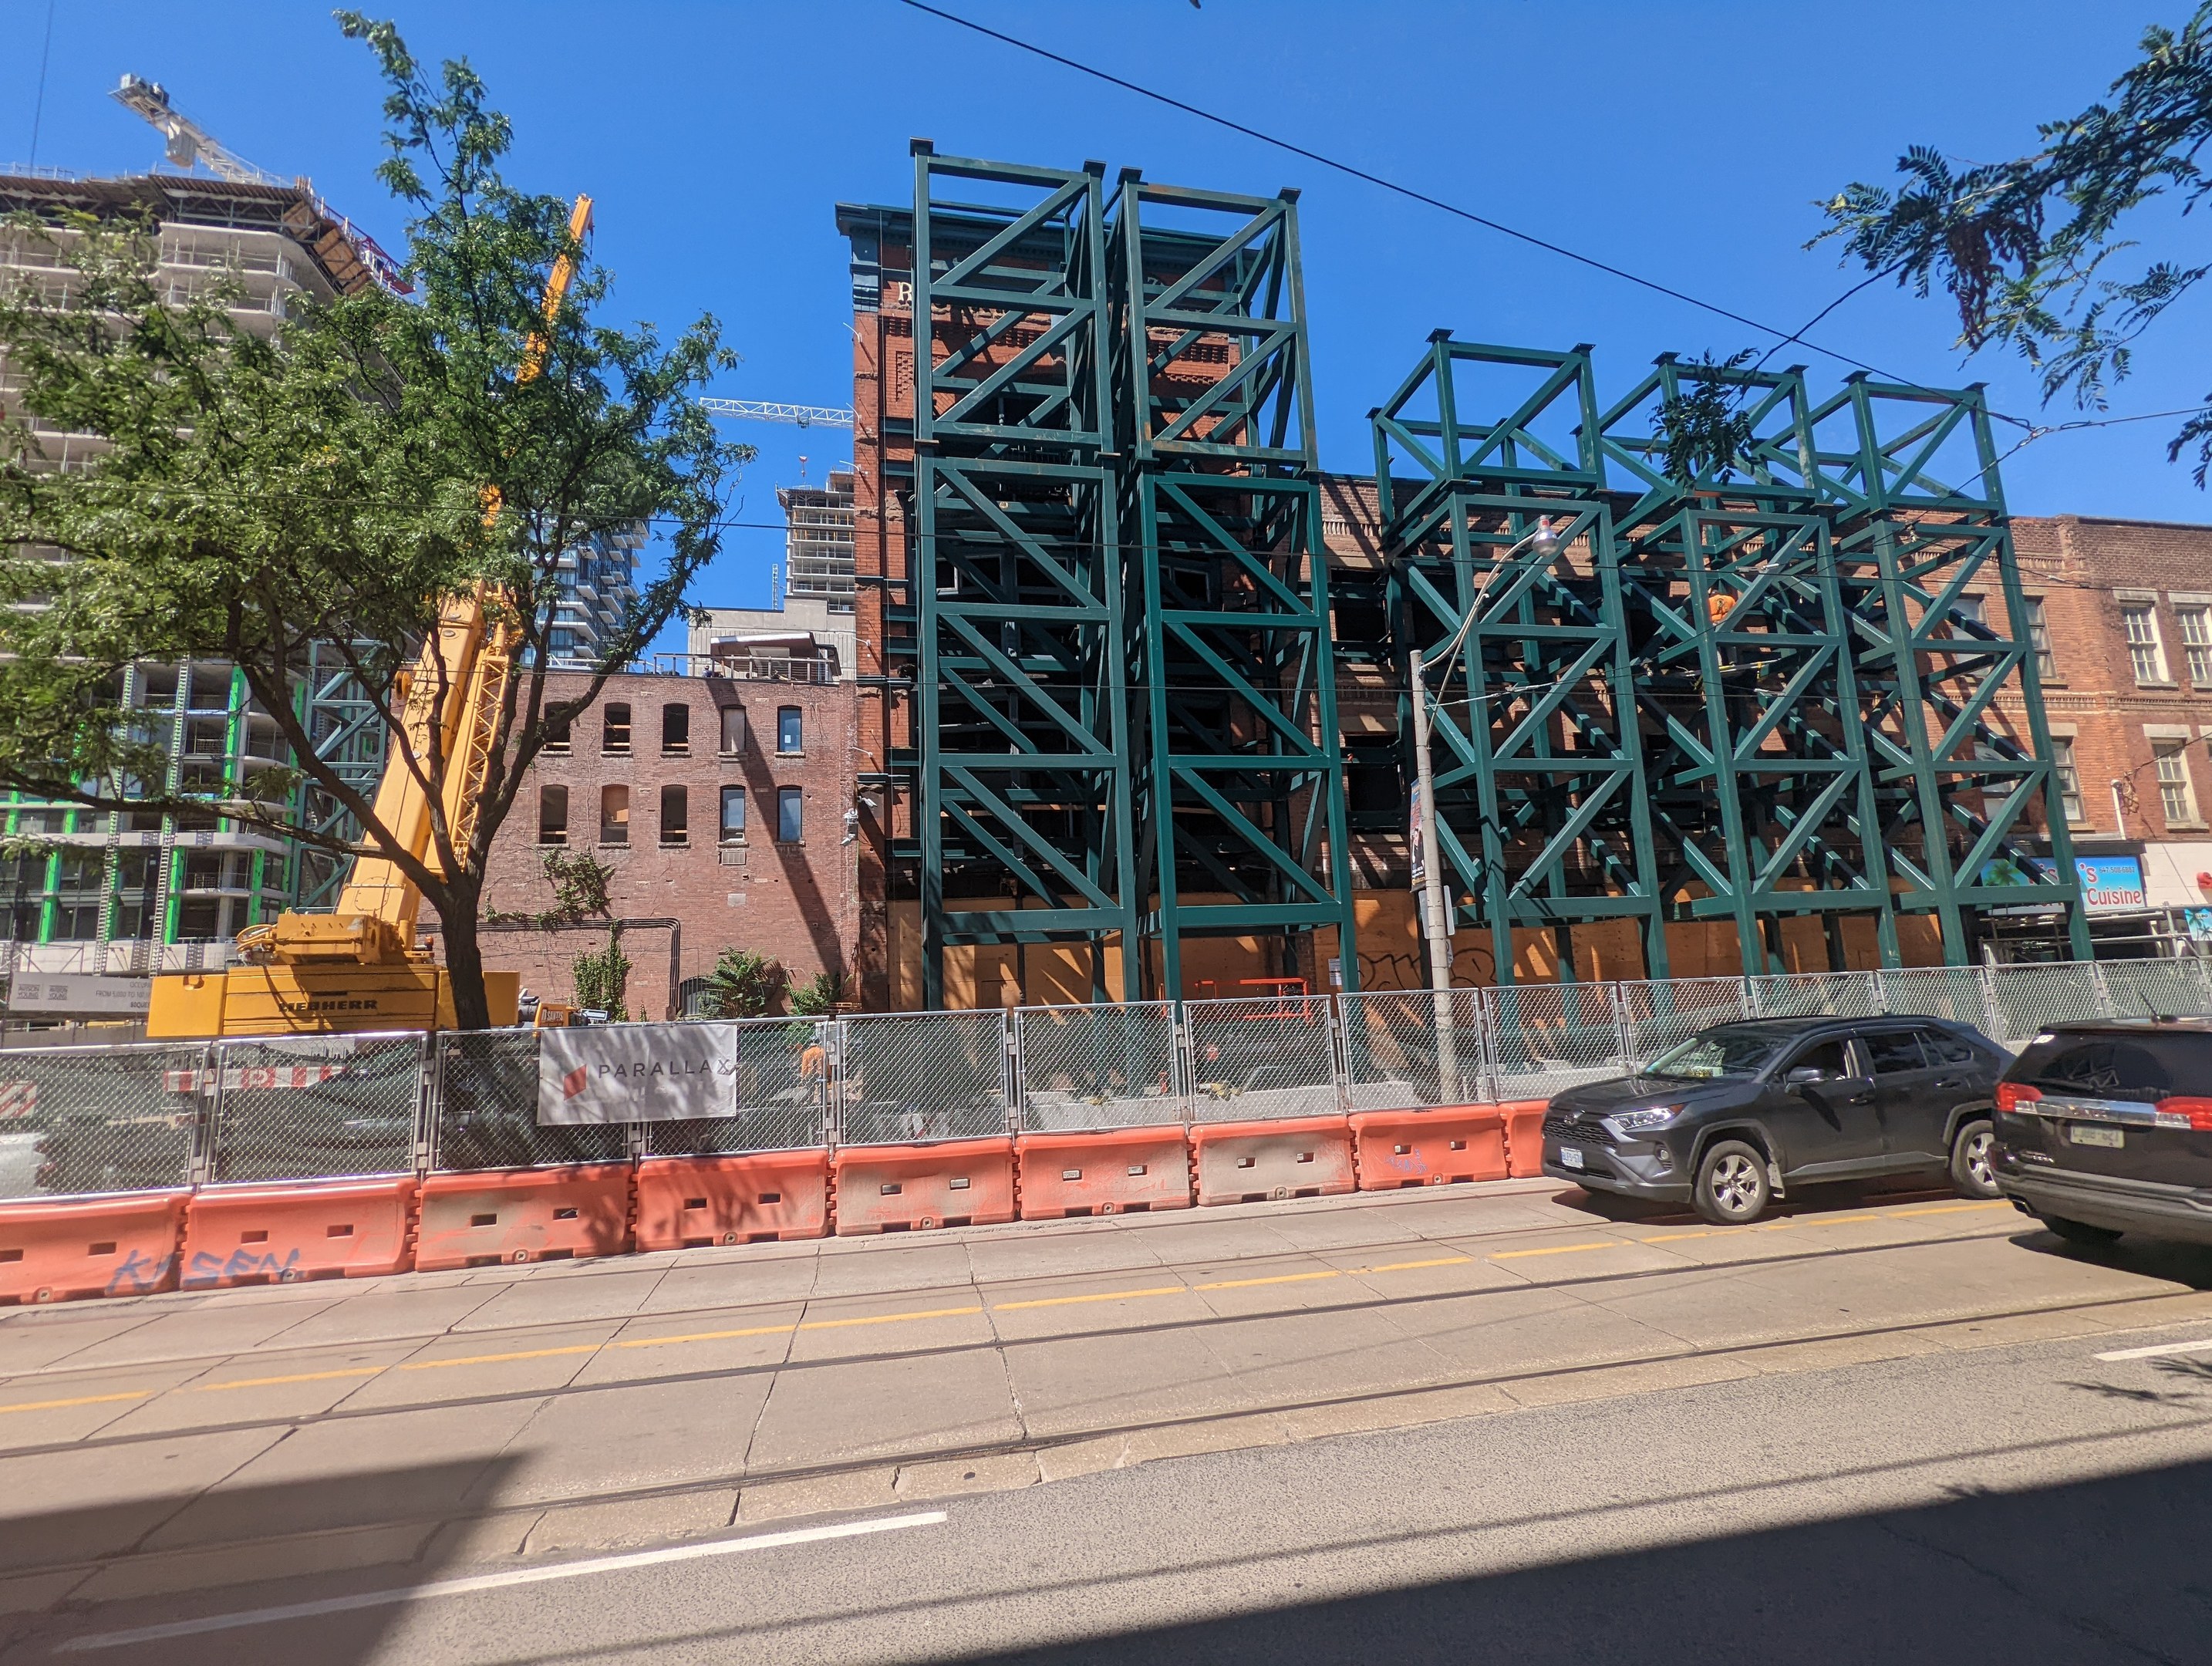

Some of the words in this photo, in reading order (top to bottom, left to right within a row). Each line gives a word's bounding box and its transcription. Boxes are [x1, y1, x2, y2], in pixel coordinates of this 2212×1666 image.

[2087, 887, 2142, 906] Cuisine
[278, 1000, 377, 1012] LIEBHERR
[599, 1059, 730, 1078] PARALLAX
